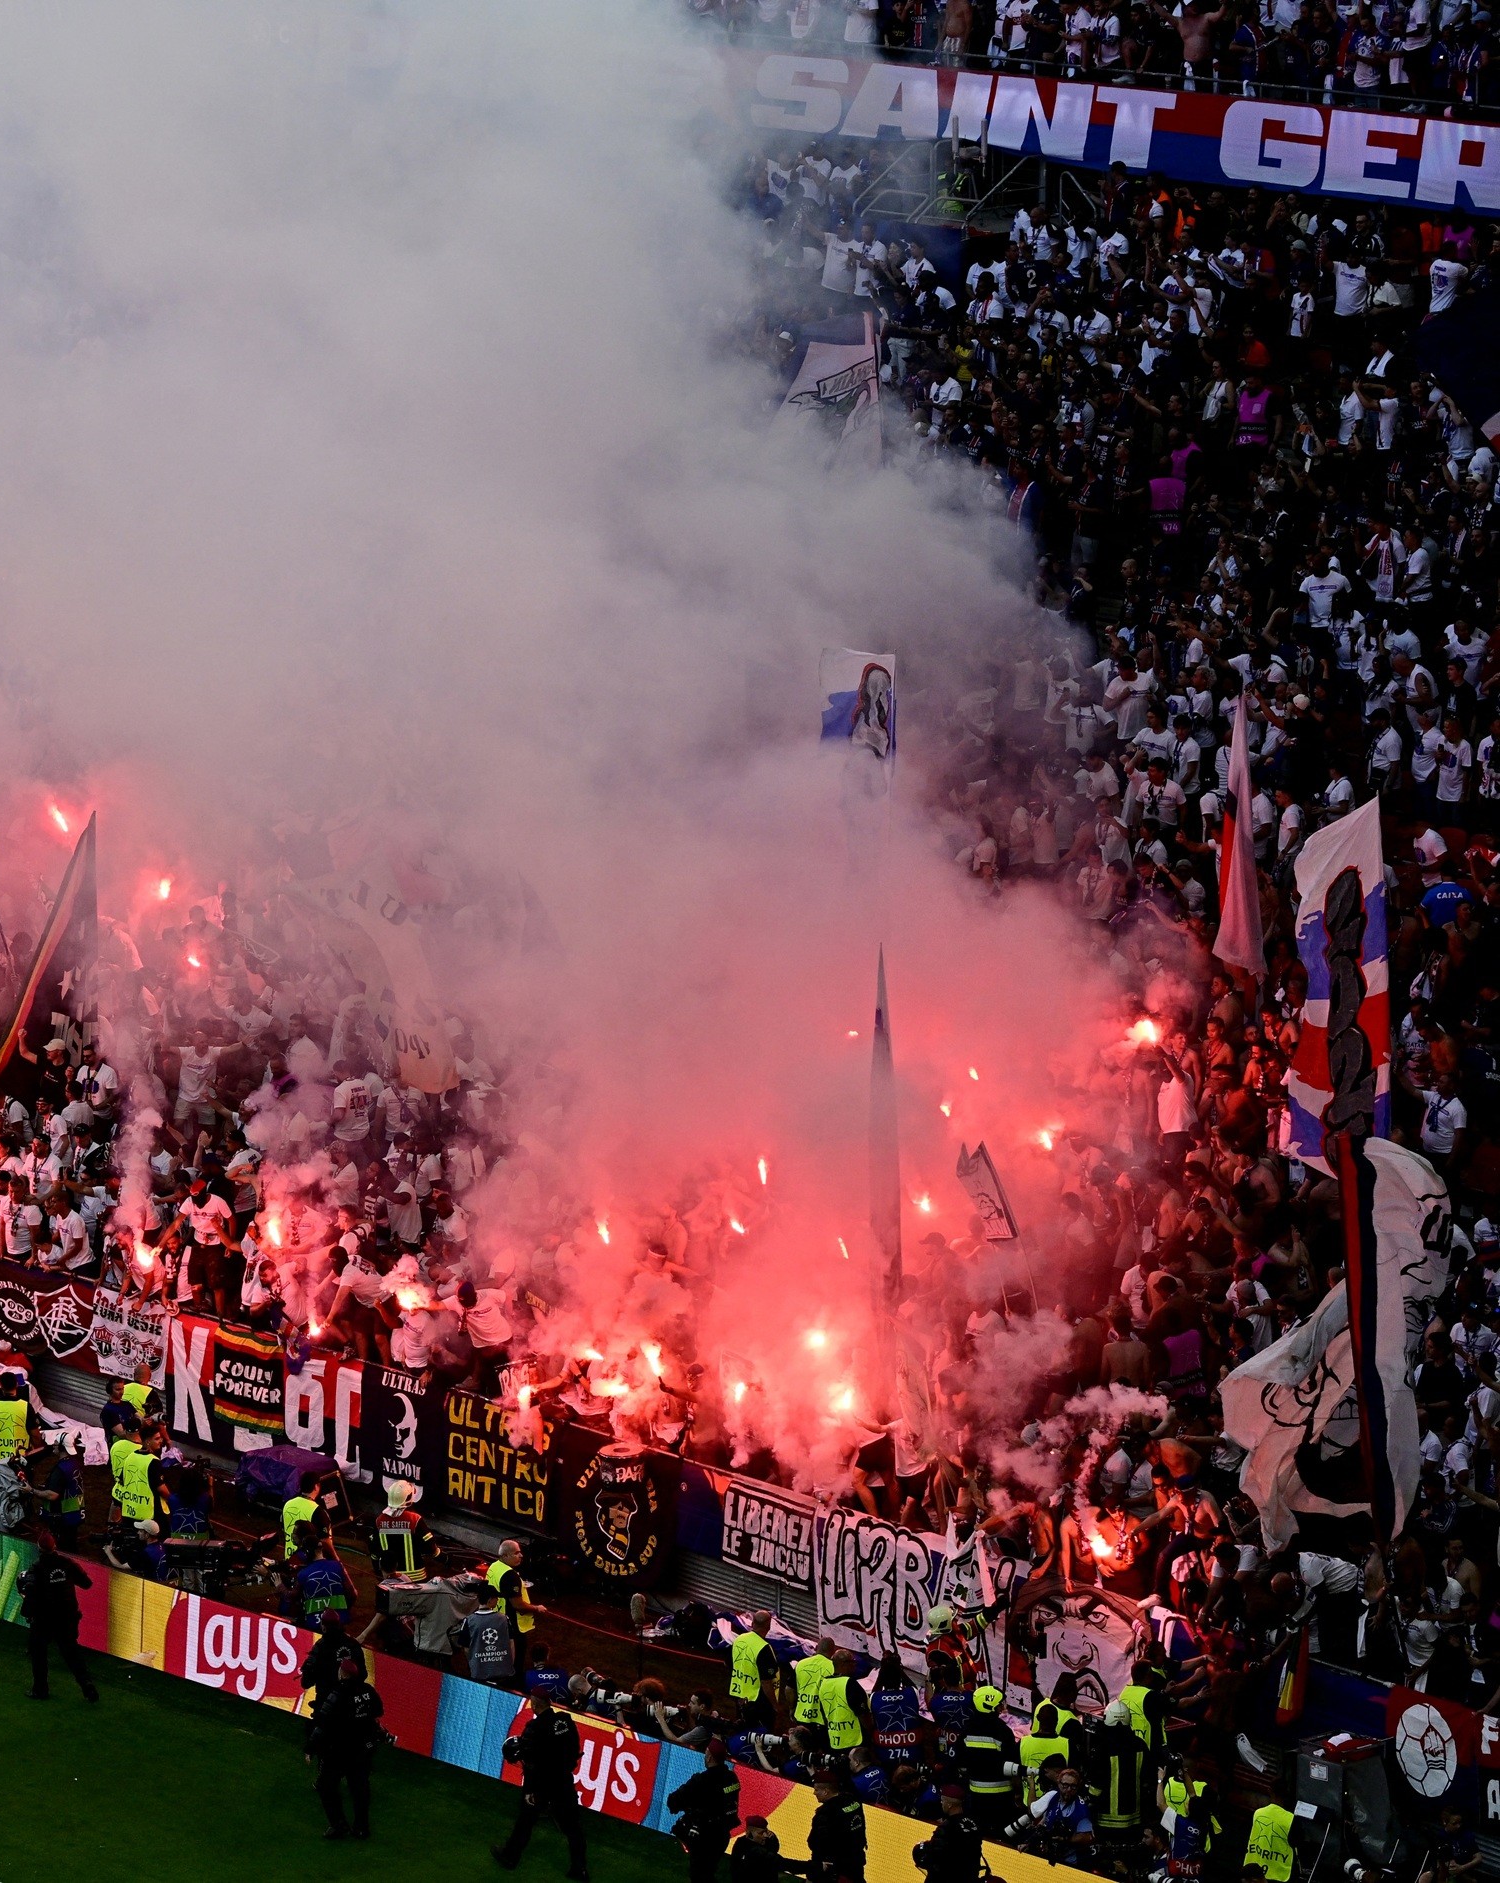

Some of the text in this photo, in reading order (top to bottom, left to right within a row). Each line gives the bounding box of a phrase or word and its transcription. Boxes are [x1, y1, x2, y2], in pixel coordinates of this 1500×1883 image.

[750, 54, 1177, 169] SAINT
[1026, 269, 1037, 289] 2
[218, 1358, 274, 1386] COULY
[381, 1371, 426, 1396] ULTRAS
[214, 1373, 282, 1405] FOREVER
[448, 1466, 546, 1523] ANTICO
[391, 1521, 411, 1531] SAFETY
[723, 1491, 812, 1555] LIBEREZ
[638, 1534, 658, 1566] SUD
[722, 1525, 743, 1557] LE
[594, 1554, 638, 1577] DELLA
[315, 1598, 331, 1610] TV
[474, 1649, 508, 1659] CHAMPIONS
[881, 1694, 904, 1702] oppo
[878, 1732, 917, 1746] PHOTO
[888, 1748, 910, 1760] 274
